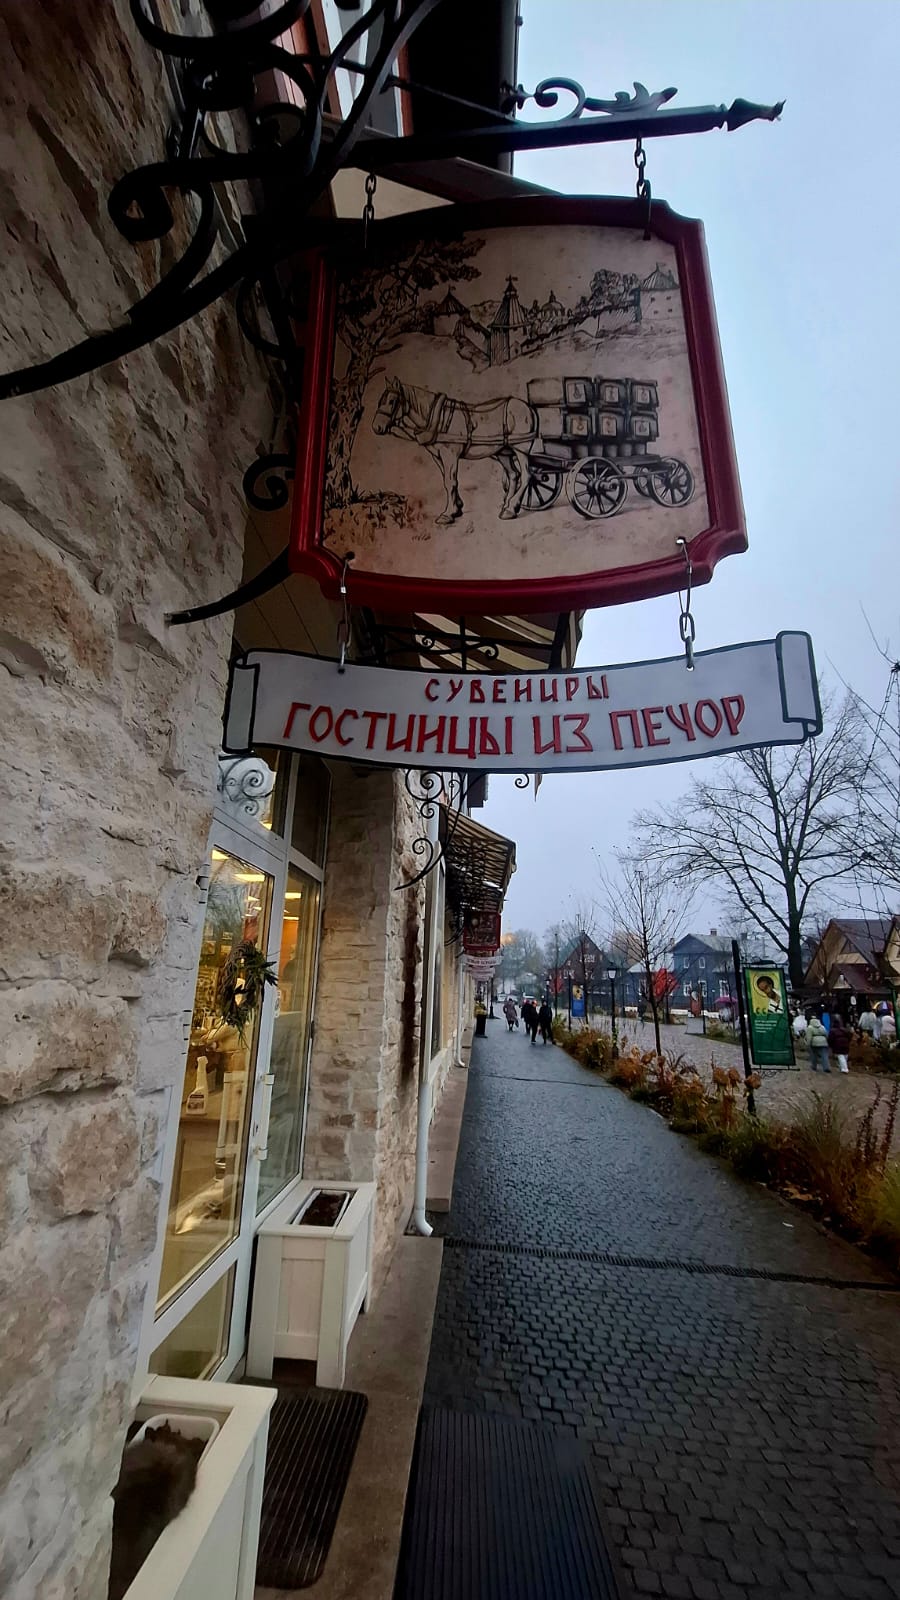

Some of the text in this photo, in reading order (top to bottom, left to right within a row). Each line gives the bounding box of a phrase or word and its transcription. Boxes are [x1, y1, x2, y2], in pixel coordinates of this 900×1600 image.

[425, 673, 607, 704] СУВЕНИРЫ
[283, 695, 746, 759] ГОСТИНЦЫ ИЗ ПЕЧОР
